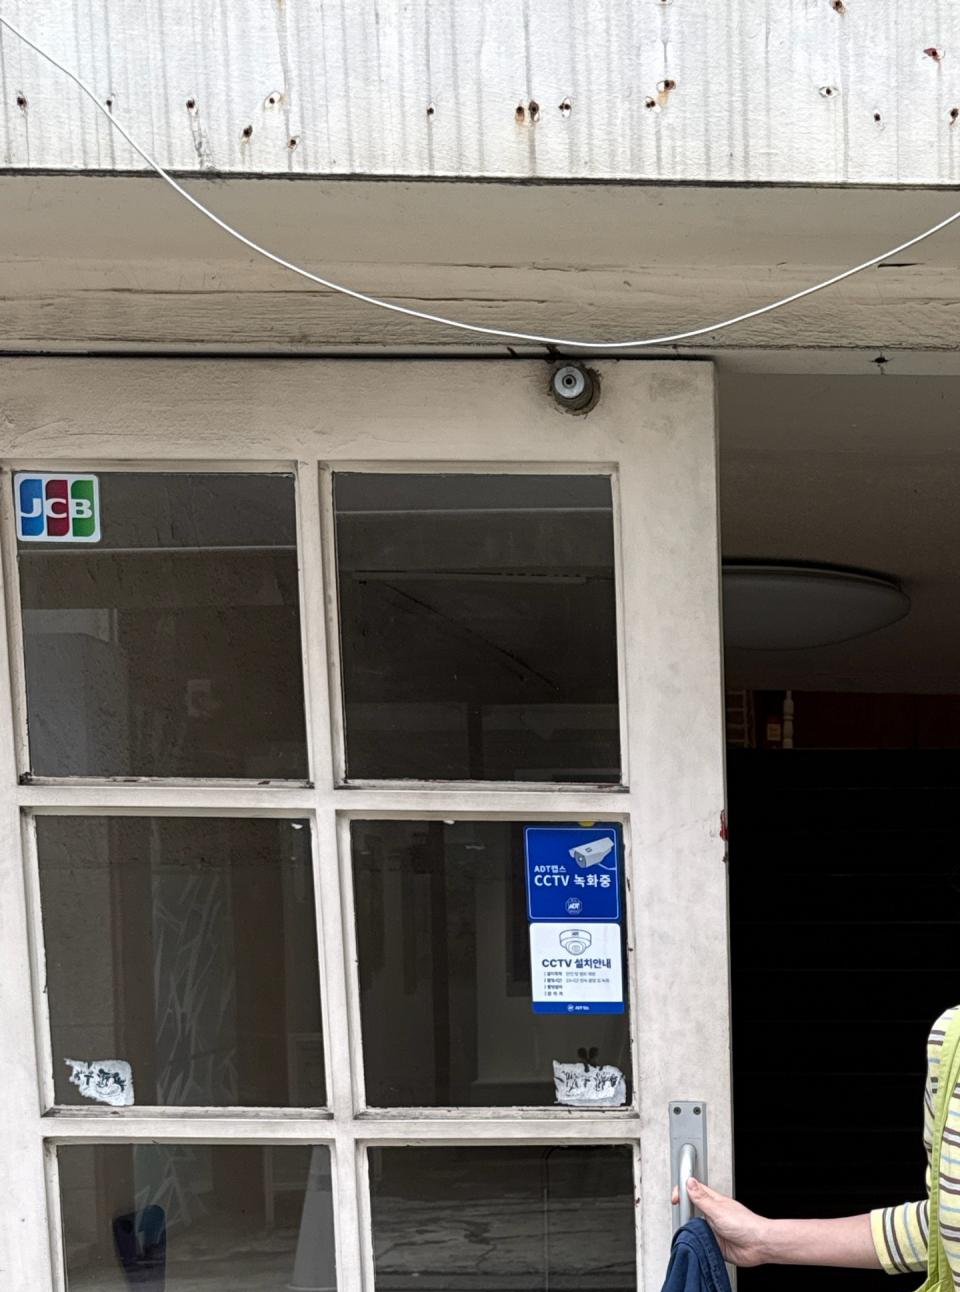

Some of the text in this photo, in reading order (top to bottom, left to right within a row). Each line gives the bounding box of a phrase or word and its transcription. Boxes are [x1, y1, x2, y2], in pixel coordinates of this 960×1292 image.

[21, 497, 93, 518] JCB
[534, 873, 612, 888] CCTV 녹화중
[542, 958, 612, 969] CCTV 설치안내
